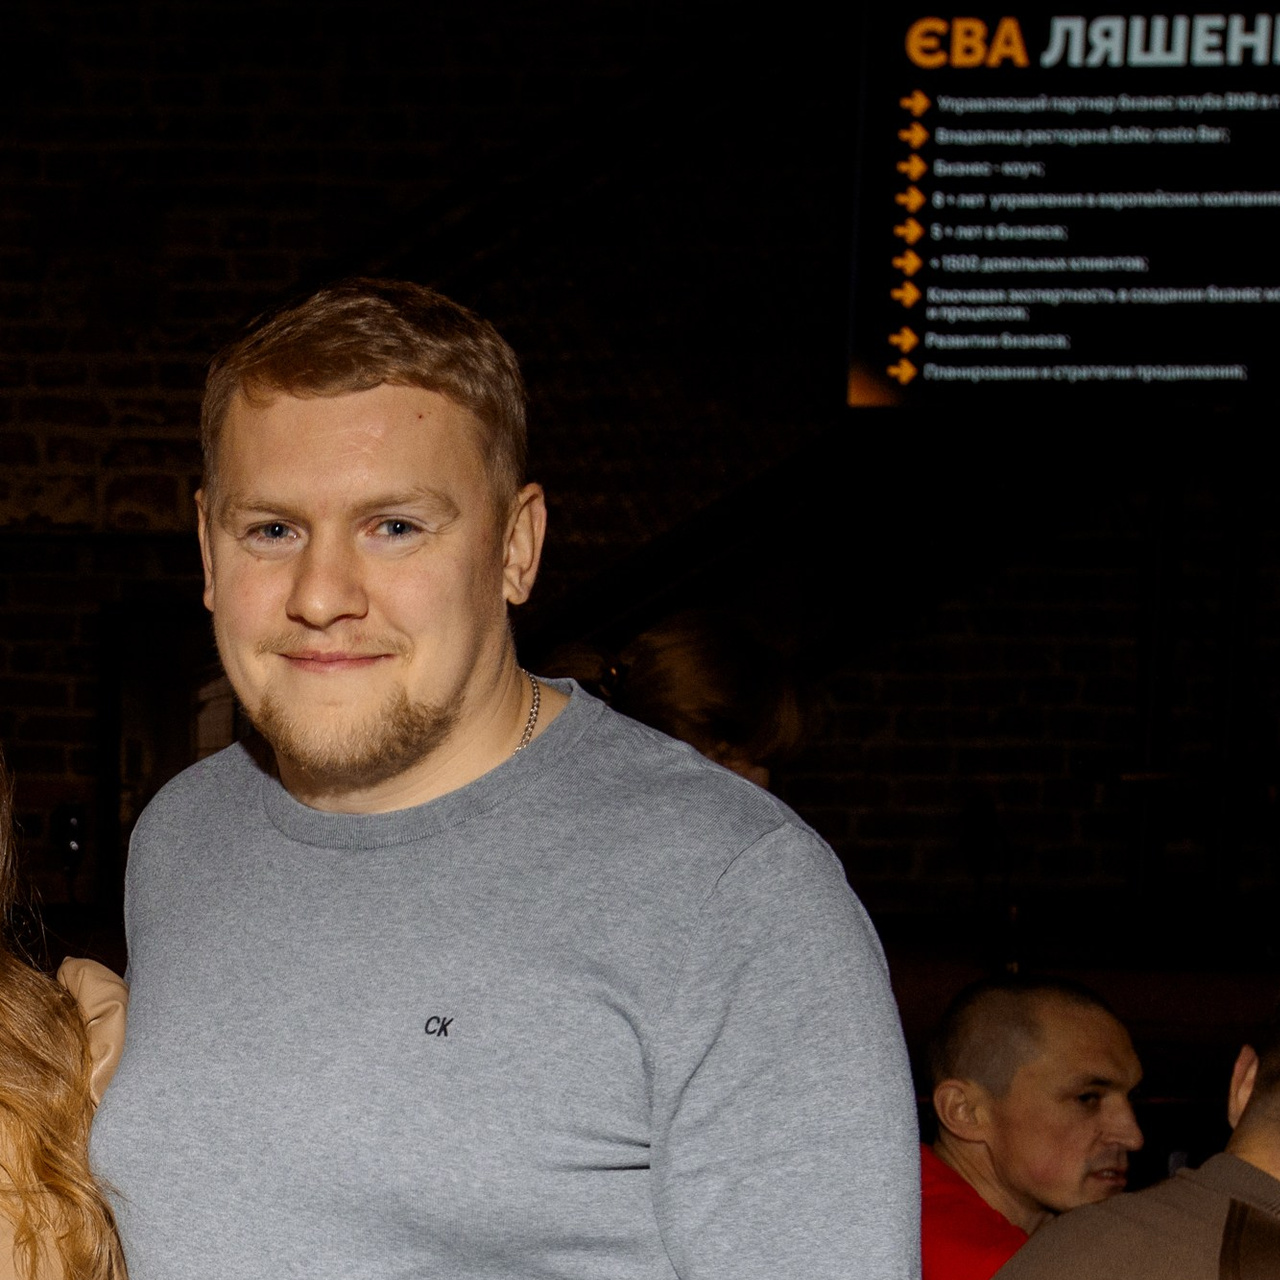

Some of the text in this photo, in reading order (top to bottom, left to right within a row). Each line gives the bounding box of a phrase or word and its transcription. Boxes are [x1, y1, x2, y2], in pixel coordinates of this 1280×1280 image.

[905, 13, 1280, 69] ЄВА ЛЯШЕН
[424, 1015, 454, 1037] CK
